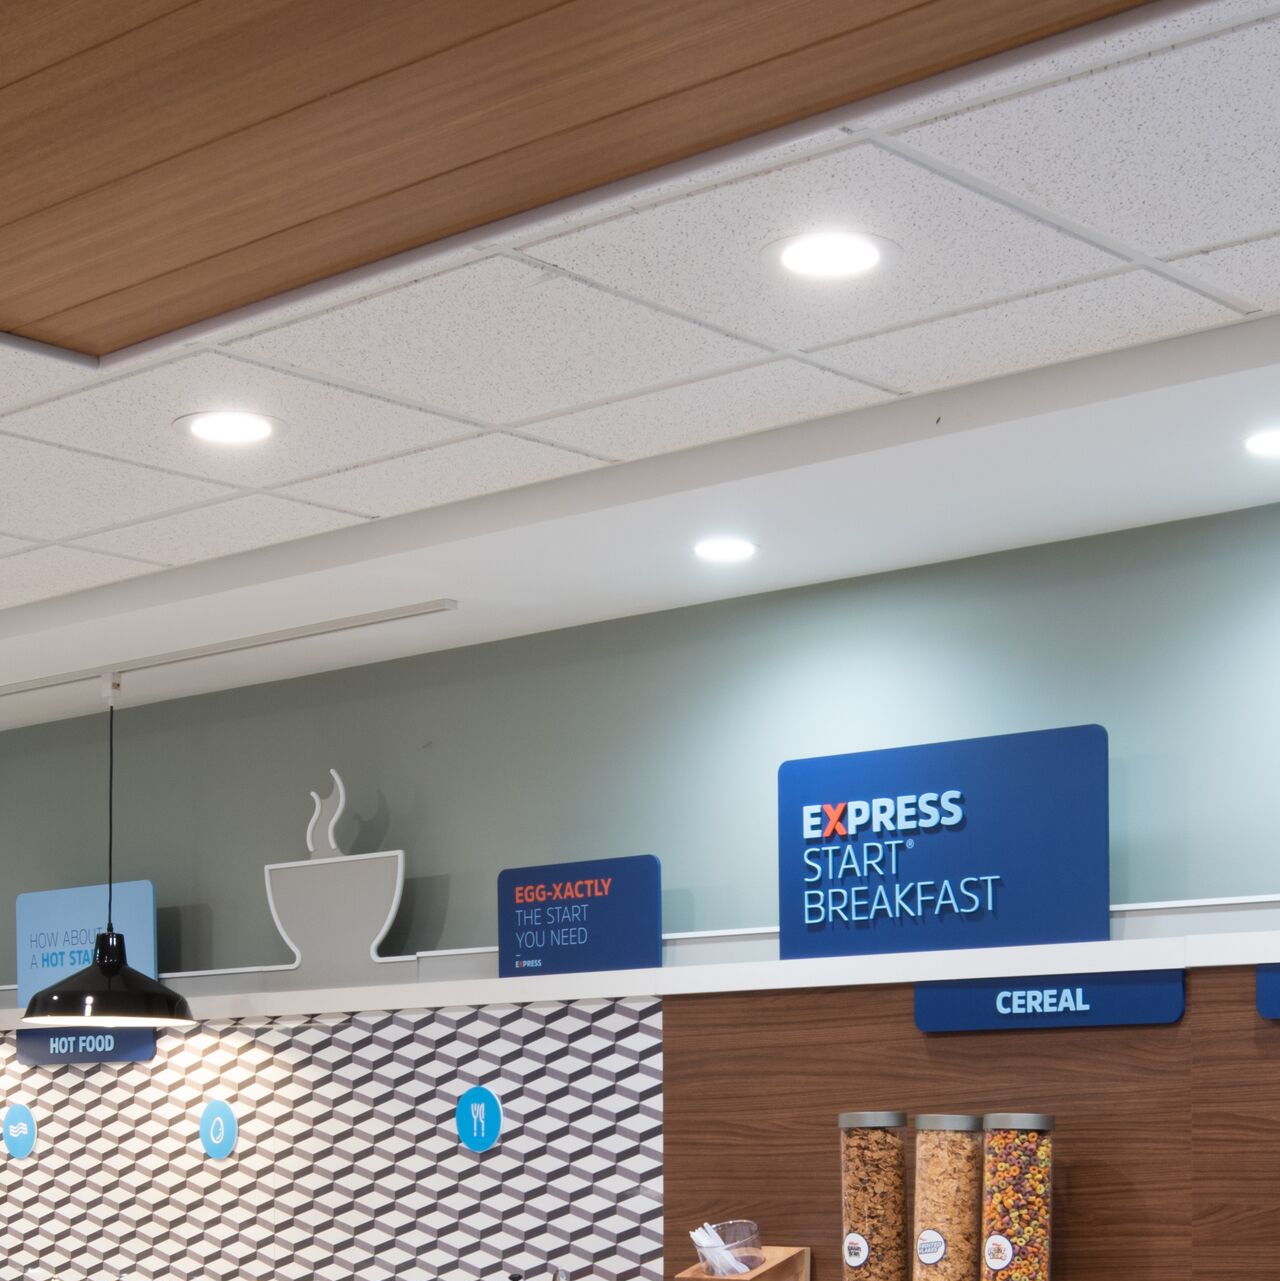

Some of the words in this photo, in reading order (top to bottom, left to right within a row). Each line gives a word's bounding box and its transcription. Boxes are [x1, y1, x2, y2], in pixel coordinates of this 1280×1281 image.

[802, 790, 964, 840] EXPRESS
[515, 877, 613, 904] EGG-XACTLY
[804, 874, 1001, 925] BREAKFAST
[515, 908, 542, 926] THE
[546, 904, 590, 925] START
[30, 931, 59, 949] HOW
[515, 931, 545, 949] YOU
[550, 927, 588, 946] NEED
[30, 953, 38, 969] A
[41, 951, 66, 968] HOT
[69, 949, 94, 966] STA
[515, 959, 542, 968] EXPRESS
[995, 987, 1091, 1015] CEREAL
[49, 1036, 76, 1054] HOT
[78, 1034, 115, 1053] FOOD
